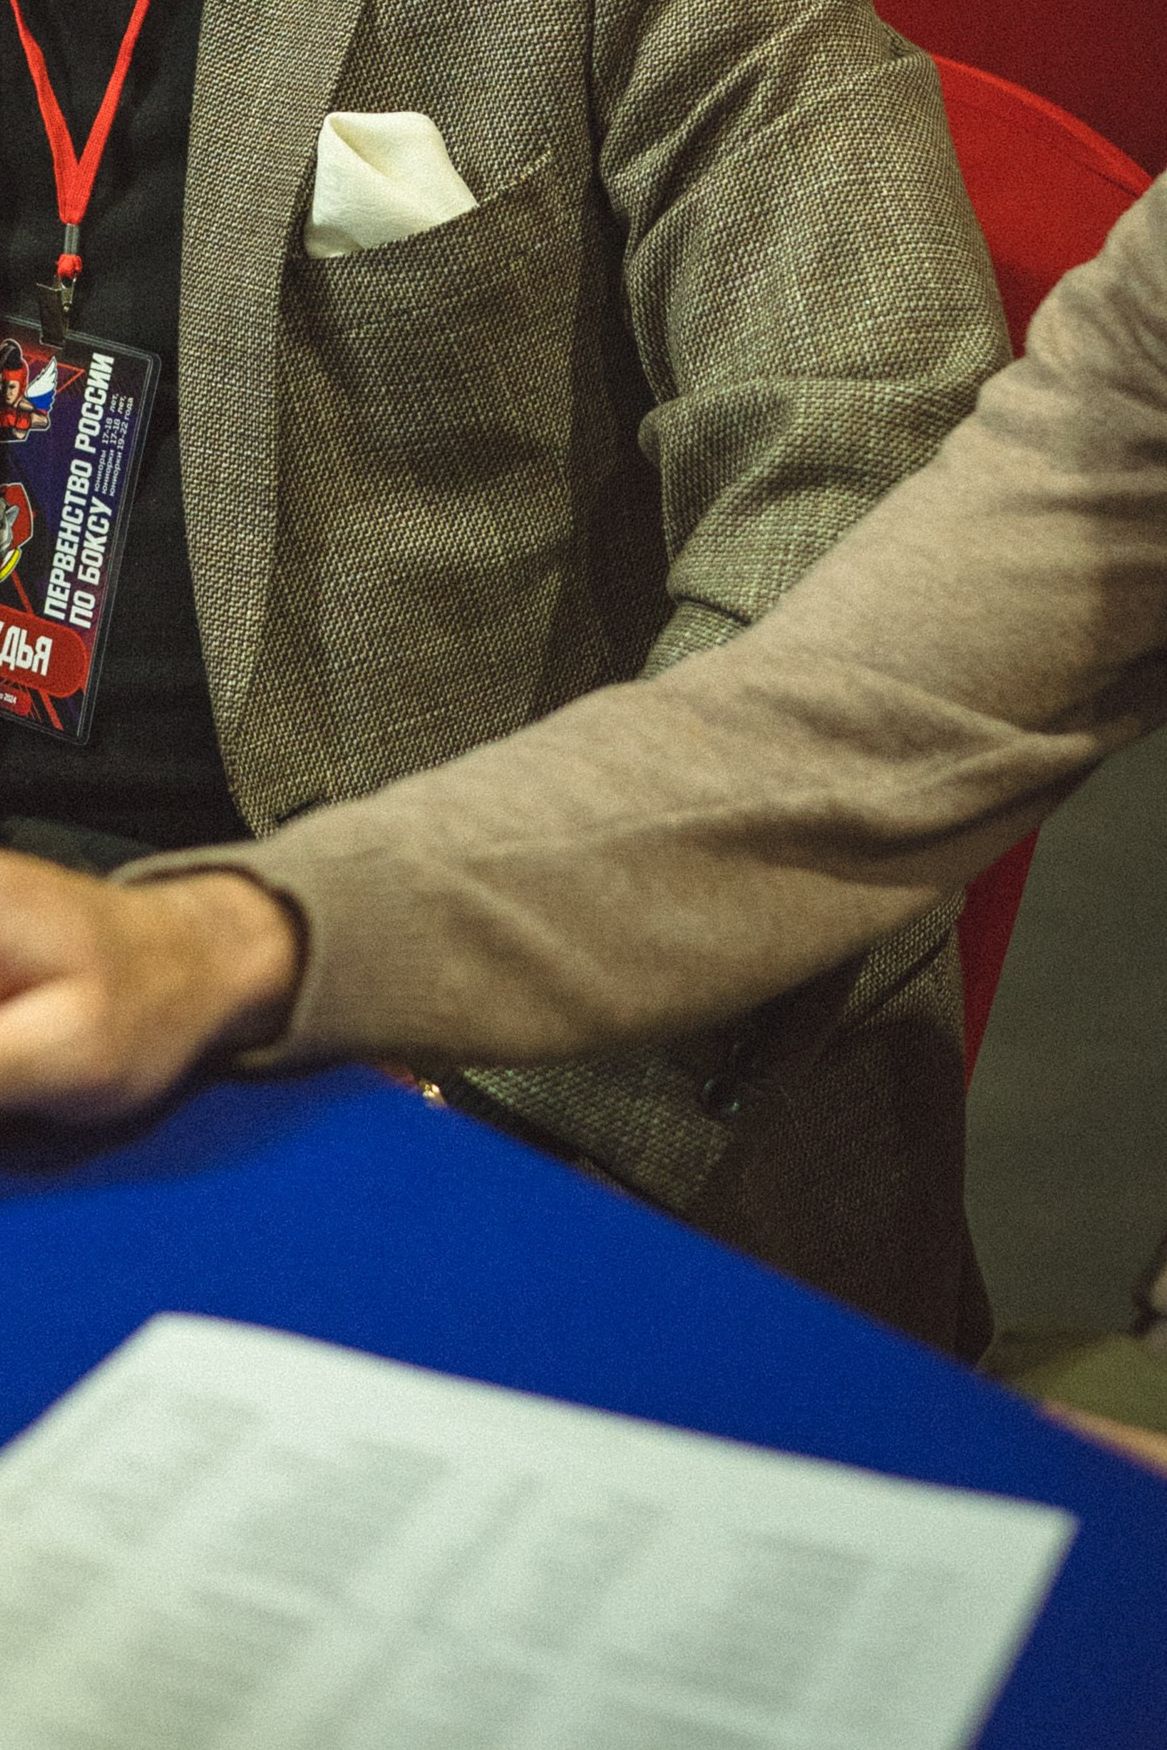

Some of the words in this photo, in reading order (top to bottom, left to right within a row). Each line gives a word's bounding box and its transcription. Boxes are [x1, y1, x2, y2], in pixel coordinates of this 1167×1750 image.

[43, 458, 93, 620] ПЕРВЕНСТВО
[74, 352, 115, 455] РОССИИ
[94, 450, 107, 492] юниоры
[102, 449, 115, 495] юниорки
[109, 452, 123, 497] юниорки
[77, 496, 113, 586] БОКСУ
[69, 590, 96, 629] ПО
